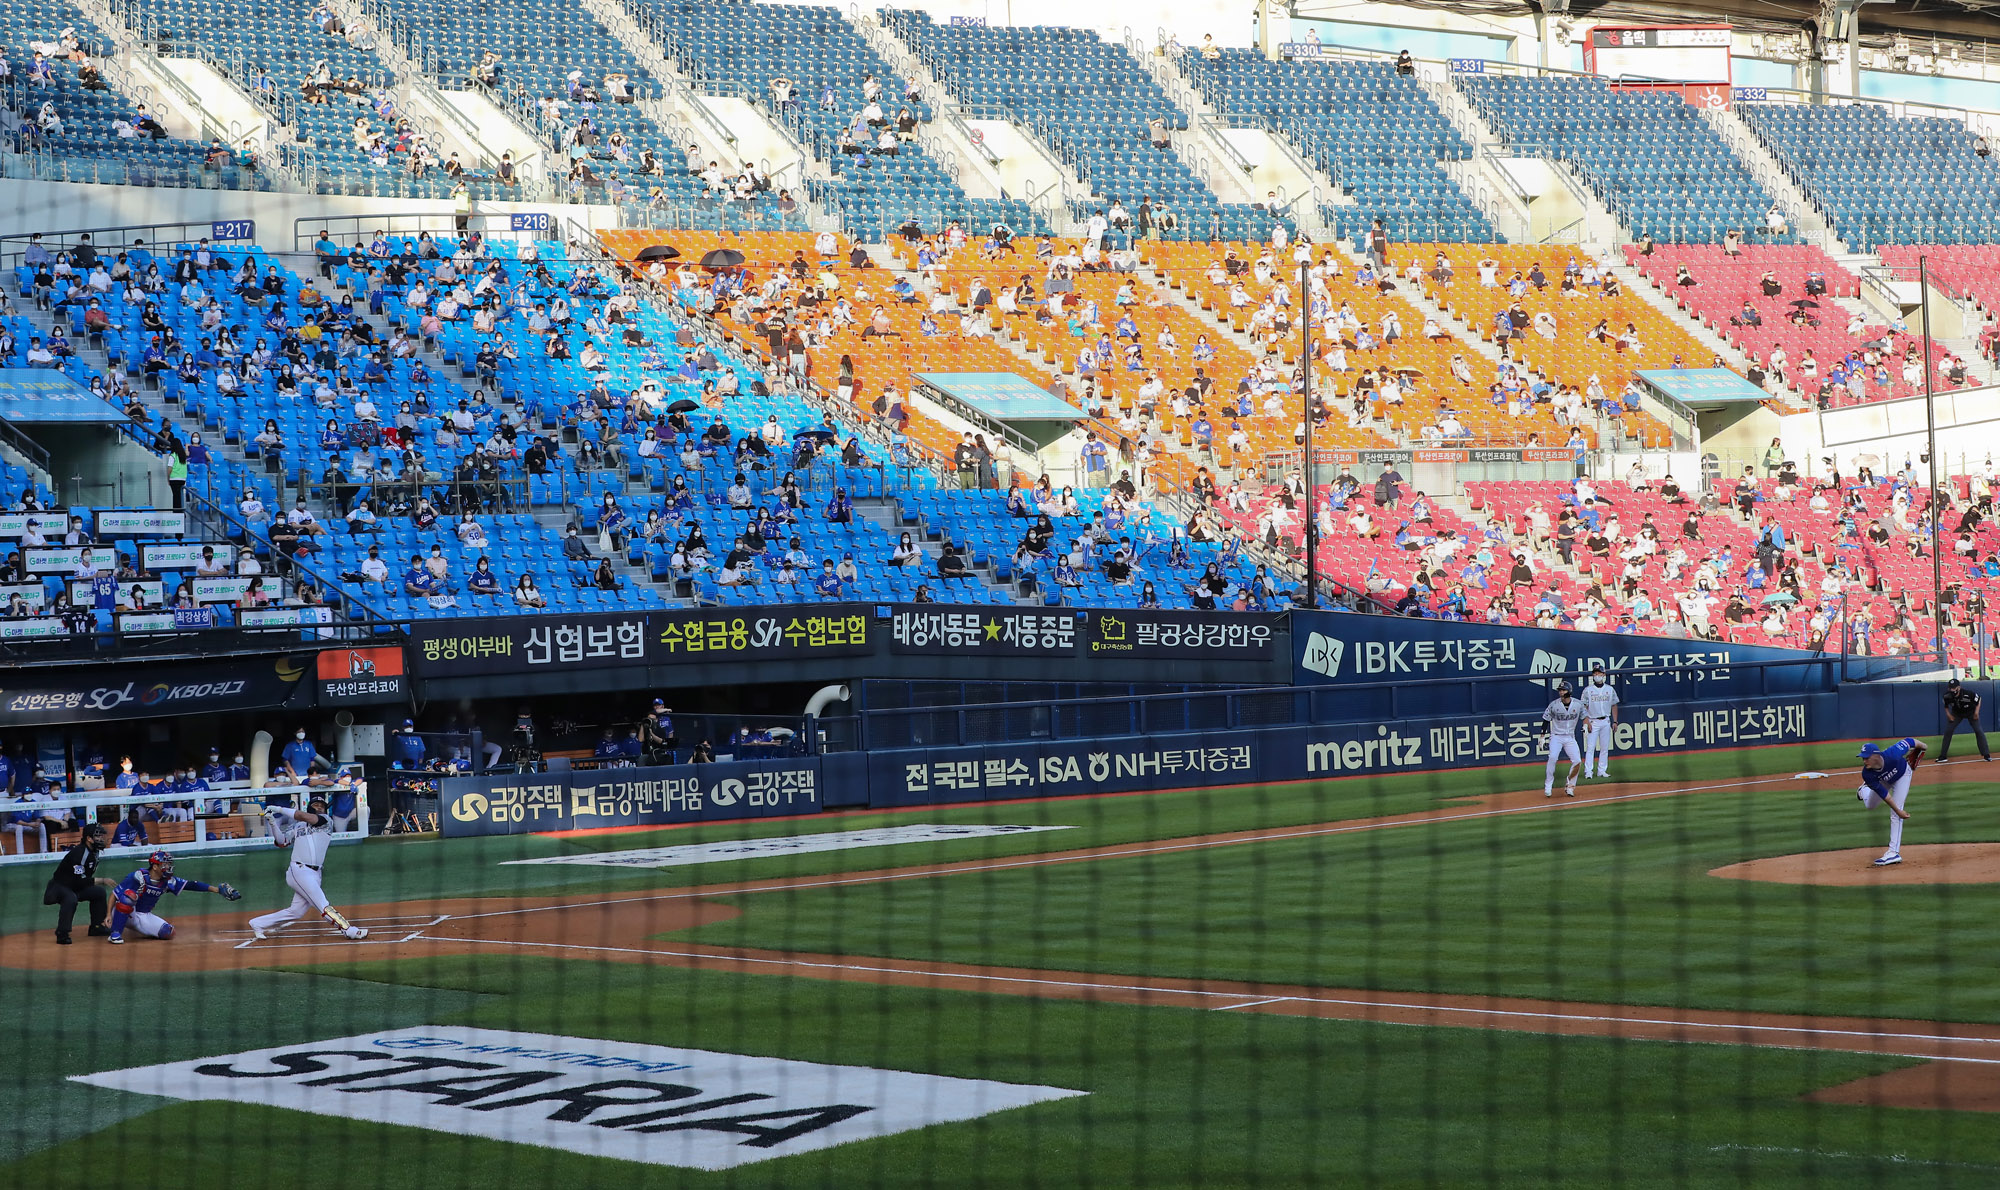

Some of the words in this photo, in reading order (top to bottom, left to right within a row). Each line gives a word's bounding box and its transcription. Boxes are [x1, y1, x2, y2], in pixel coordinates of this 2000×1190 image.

[1294, 44, 1316, 57] 330
[1461, 60, 1481, 71] 331
[1744, 88, 1765, 100] 332
[523, 215, 547, 229] 218
[1072, 222, 1088, 233] 220
[226, 222, 250, 238] 217
[1316, 228, 1332, 237] 221
[1560, 230, 1577, 239] 222
[1312, 453, 1352, 462] 산인프라코어
[102, 519, 119, 527] G마켓
[120, 519, 140, 527] 프로야구
[143, 519, 160, 527] G마켓
[161, 519, 181, 527] 프로야구
[29, 557, 47, 565] G마켓
[48, 557, 69, 565] 프로야구
[148, 553, 165, 562] G마켓
[165, 553, 186, 561] 프로야구
[99, 584, 111, 596] 65
[196, 587, 214, 595] G마켓
[176, 611, 209, 624] 최강삼성
[321, 612, 327, 622] 5
[4, 628, 23, 637] G마켓
[23, 627, 46, 635] 프로야구
[75, 621, 86, 633] 14
[124, 622, 142, 631] G마켓
[893, 612, 982, 647] 태성자동문
[660, 618, 749, 653] 수협금융
[750, 618, 782, 648] Sh
[784, 615, 866, 647] 수협보험
[1136, 622, 1272, 649] 팔공상강한우
[423, 635, 513, 661] 평생어부바
[523, 621, 644, 664] 신협보험
[1355, 637, 1516, 674] IBK투자증권
[325, 679, 399, 698] 두산인프라코어
[10, 692, 84, 712] 신한은행
[83, 682, 135, 710] SOL
[1693, 704, 1806, 745] 메리츠화재
[1306, 724, 1423, 772] meritz
[905, 763, 929, 792] 전
[933, 761, 980, 790] 국민
[984, 758, 1035, 788] 필수,
[1039, 755, 1083, 783] ISA
[1115, 745, 1251, 778] NH투자증권
[490, 784, 563, 823] 금강주택
[597, 777, 703, 816] 금강펜테리움
[747, 769, 815, 807] 금강주택
[193, 1050, 878, 1149] STARIA
